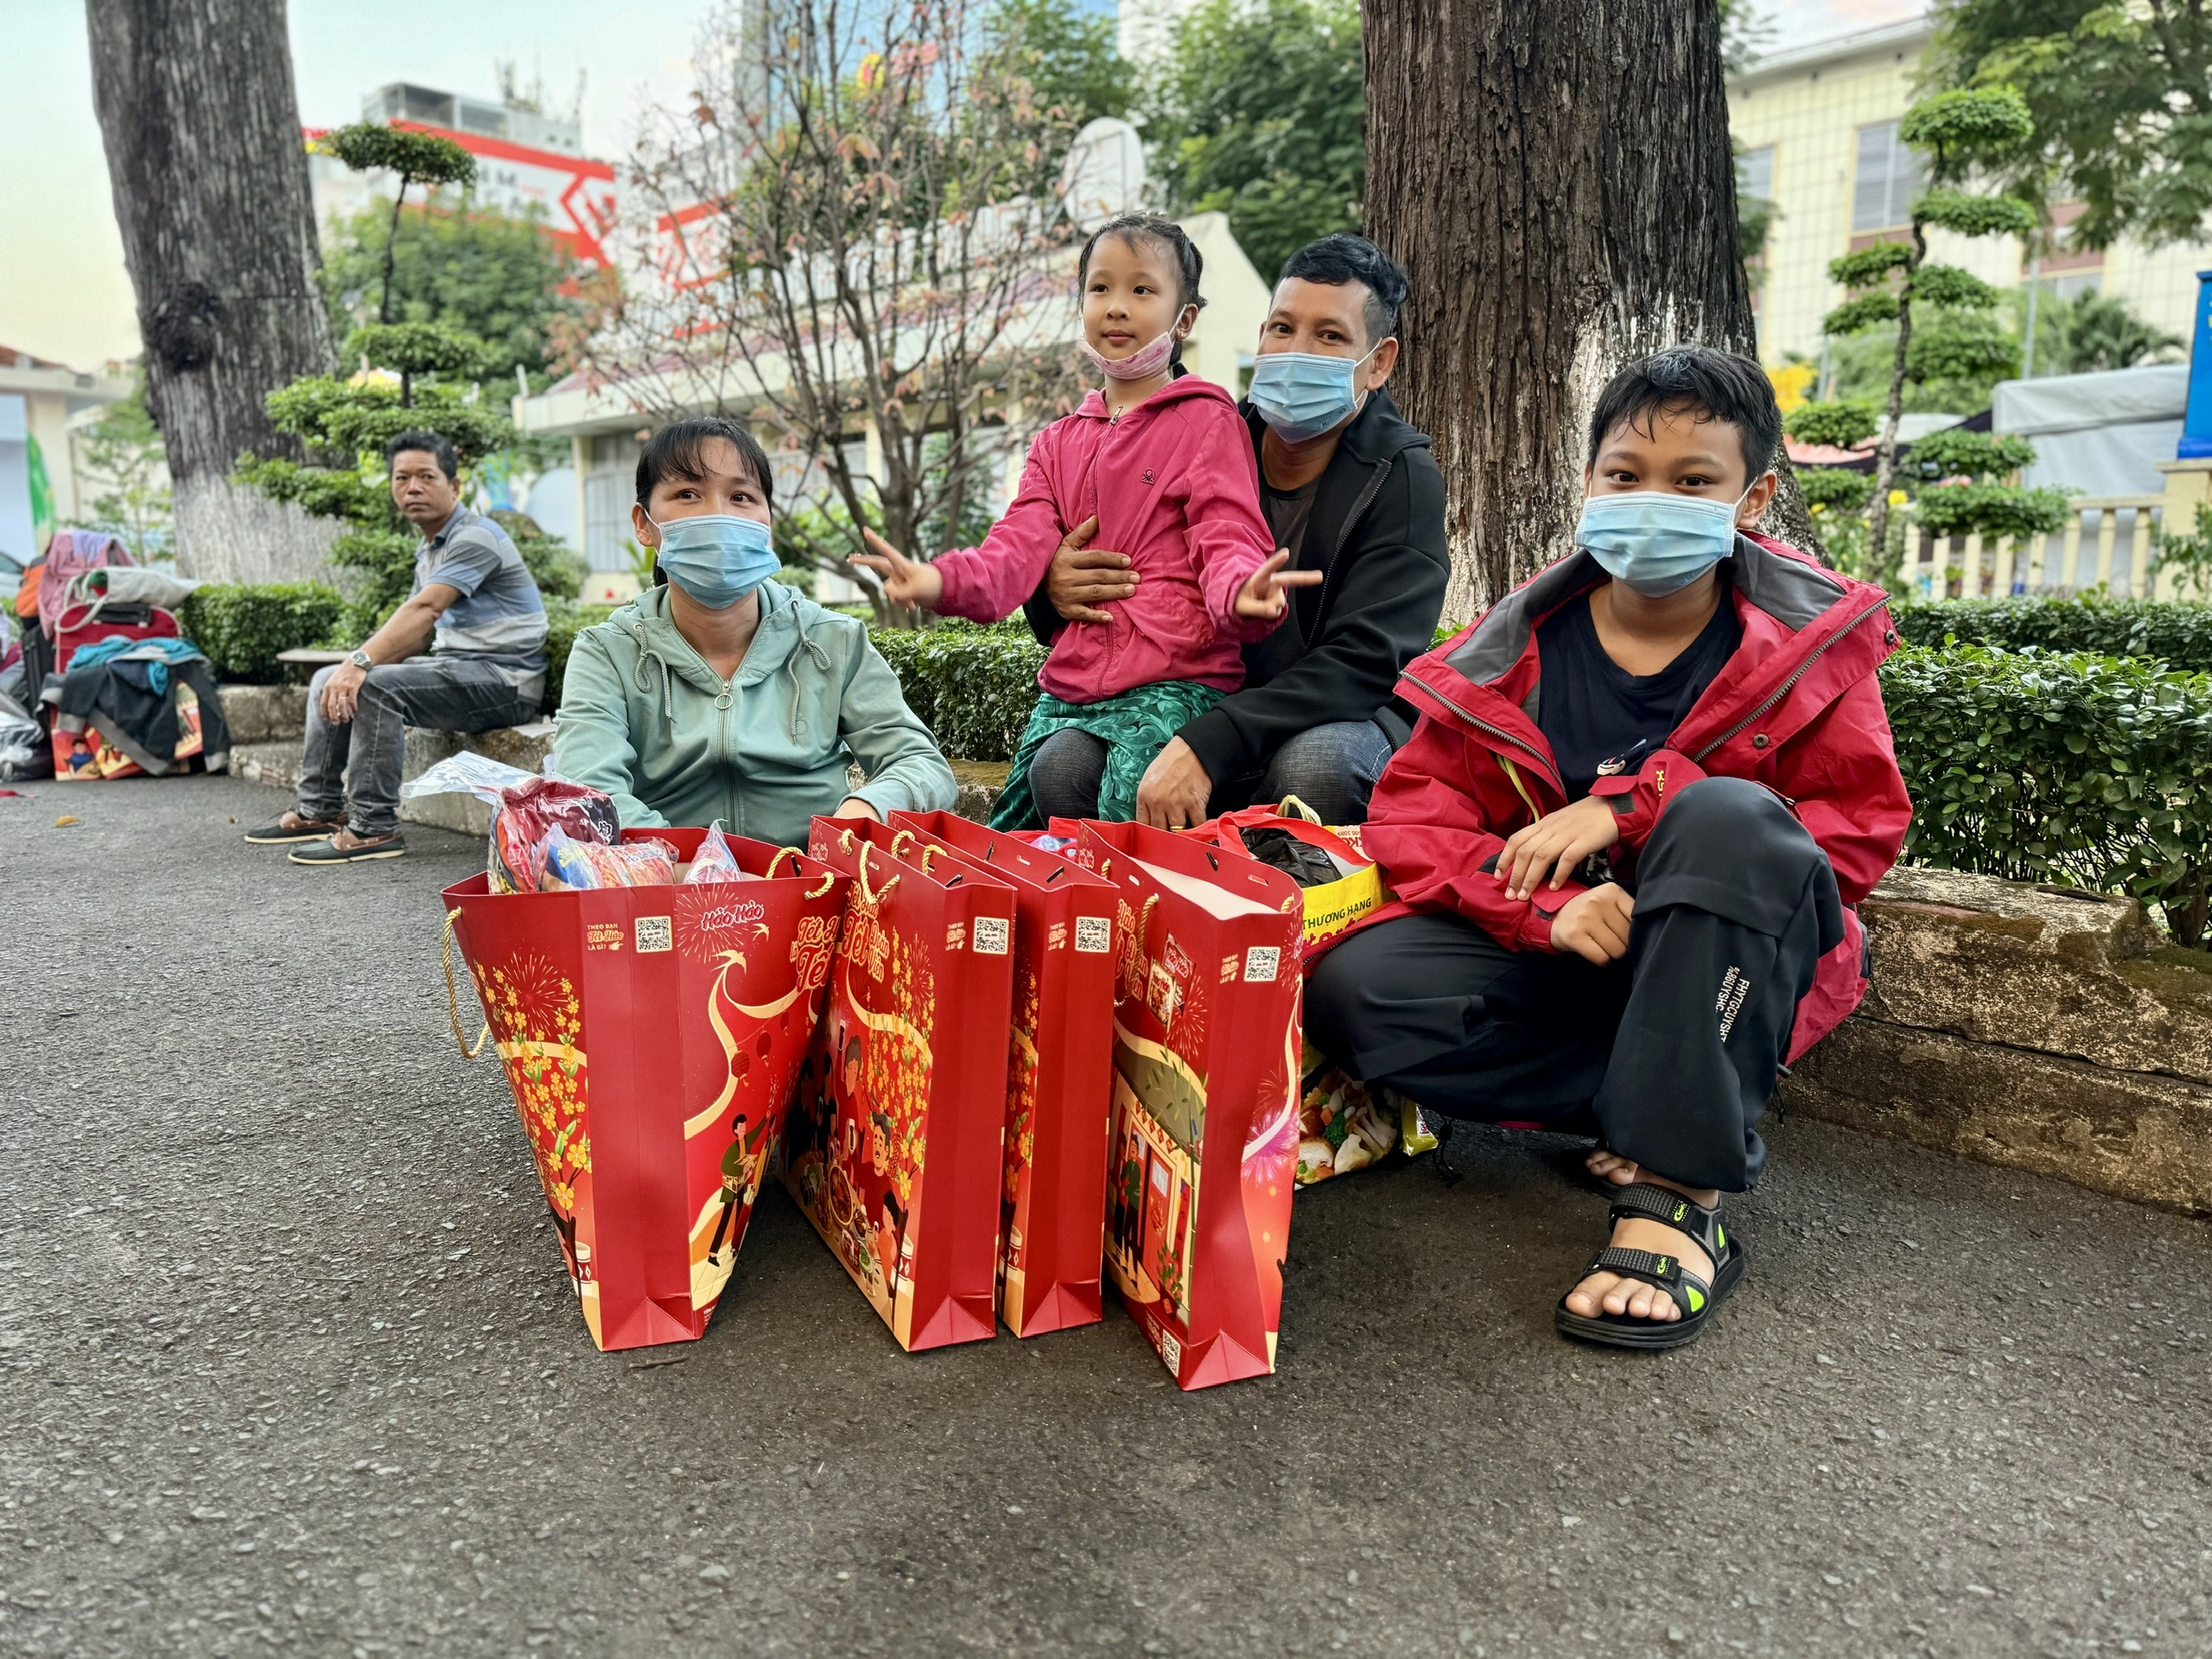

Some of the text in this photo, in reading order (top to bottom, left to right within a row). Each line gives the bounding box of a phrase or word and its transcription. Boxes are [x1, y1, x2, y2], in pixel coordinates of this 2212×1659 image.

[701, 899, 764, 931] Hảo Hảo
[1347, 898, 1371, 916] HẠNG
[798, 916, 824, 945] Tết
